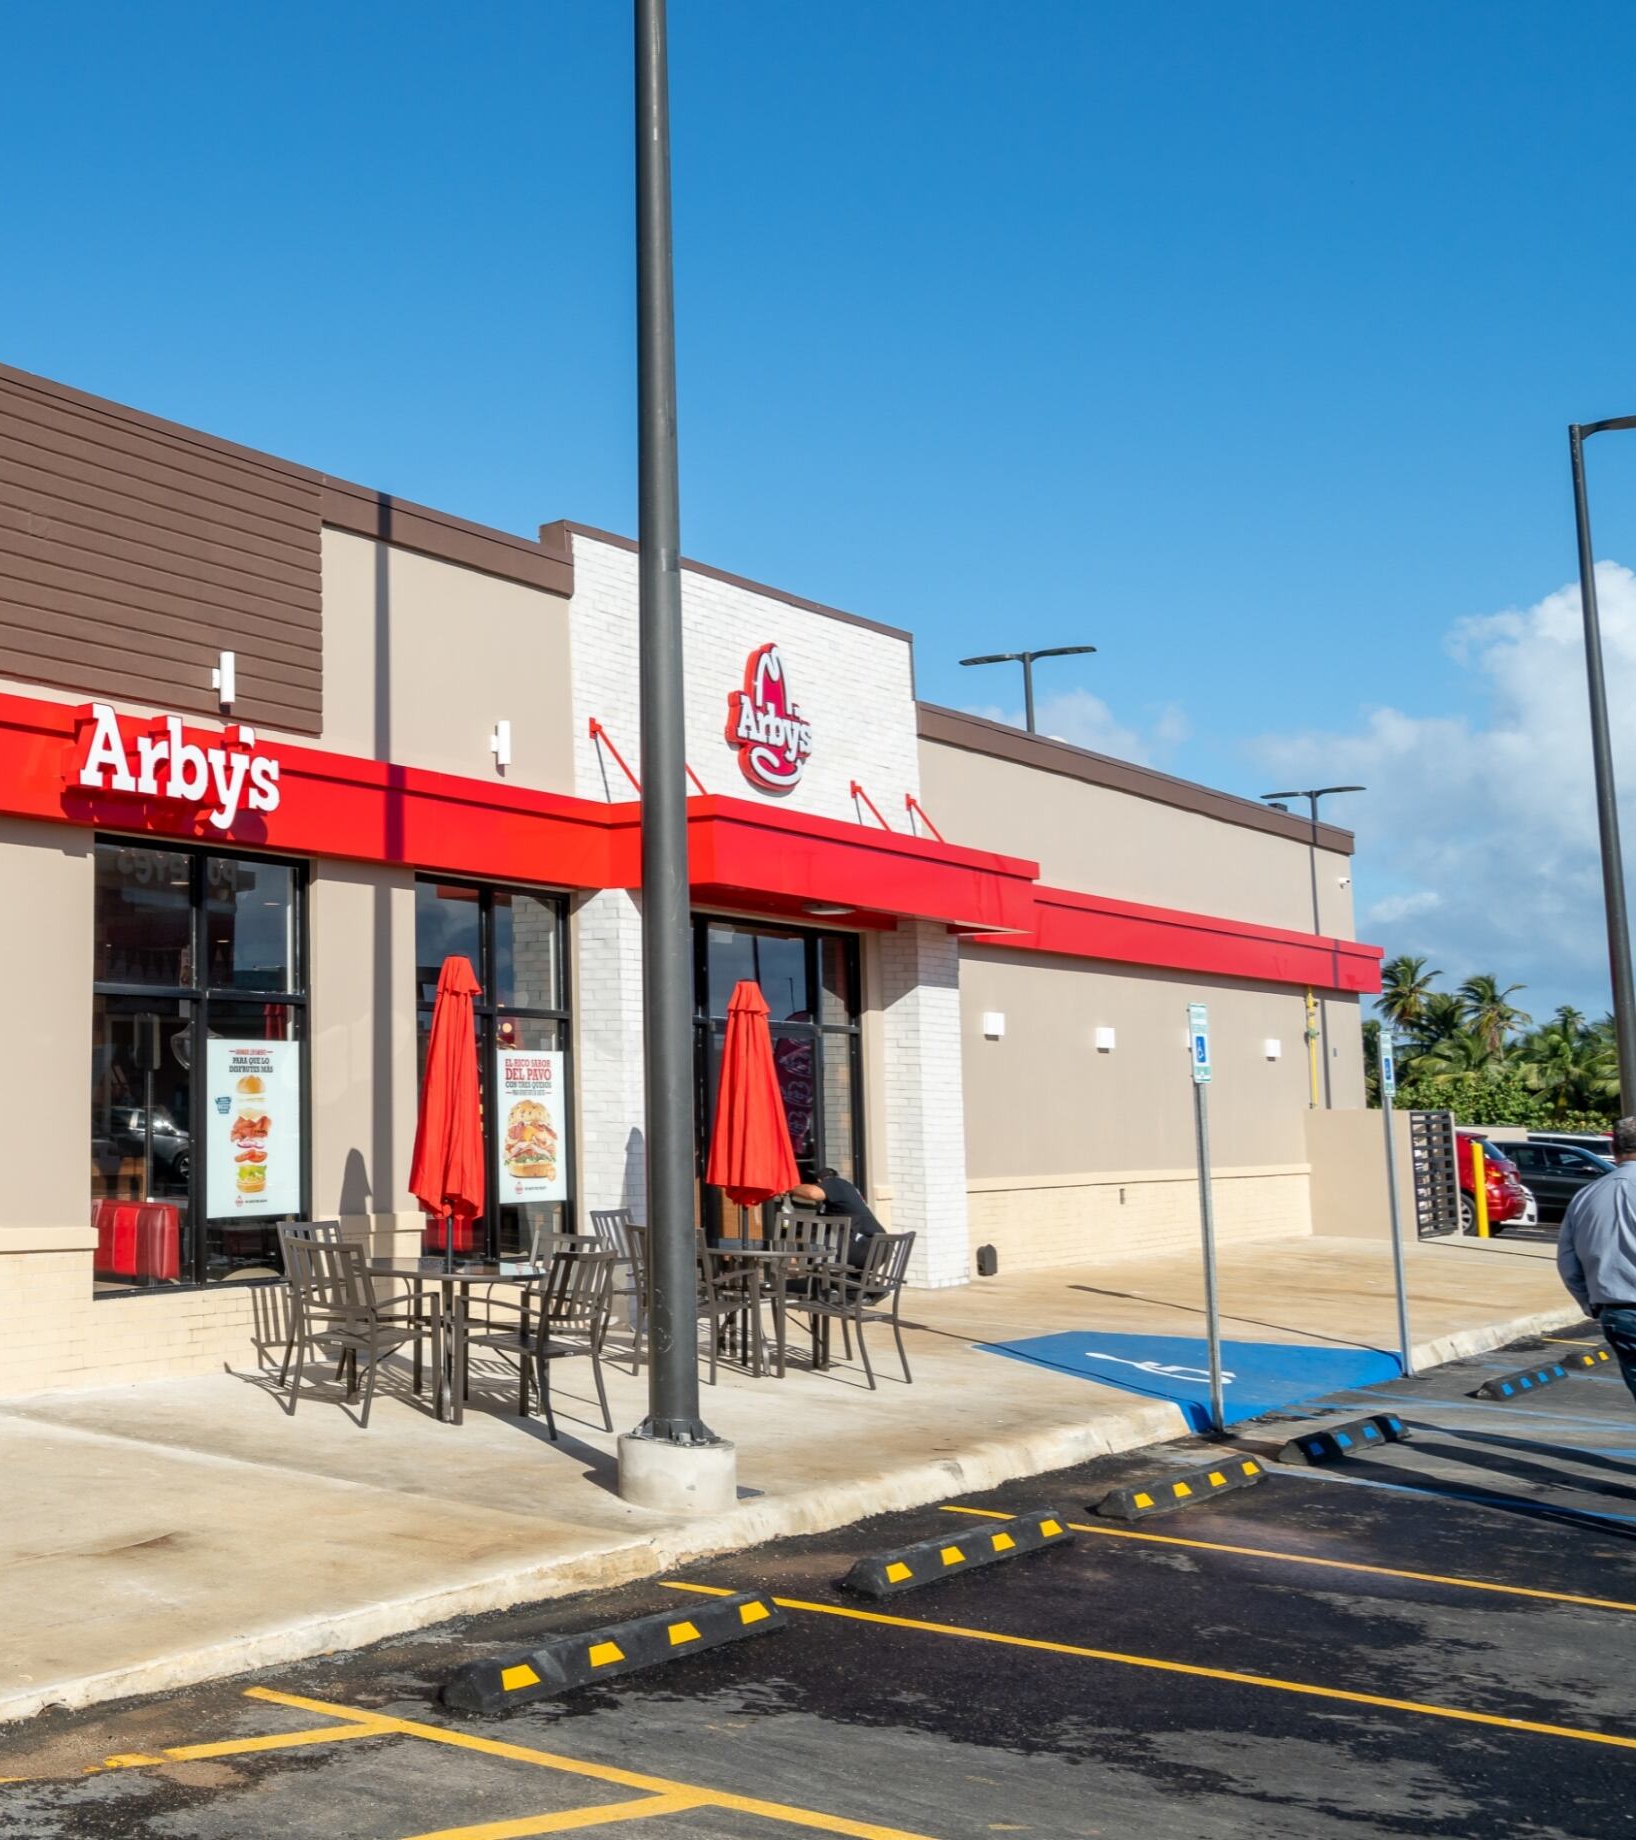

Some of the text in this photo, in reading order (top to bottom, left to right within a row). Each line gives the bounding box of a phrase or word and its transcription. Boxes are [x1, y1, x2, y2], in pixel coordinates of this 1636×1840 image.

[737, 693, 813, 763] Arby's
[79, 702, 281, 830] Arby's
[232, 1057, 248, 1065] PARA
[505, 1058, 513, 1067] EL
[531, 1059, 551, 1068] SABOR
[505, 1068, 552, 1080] DEL PAVO
